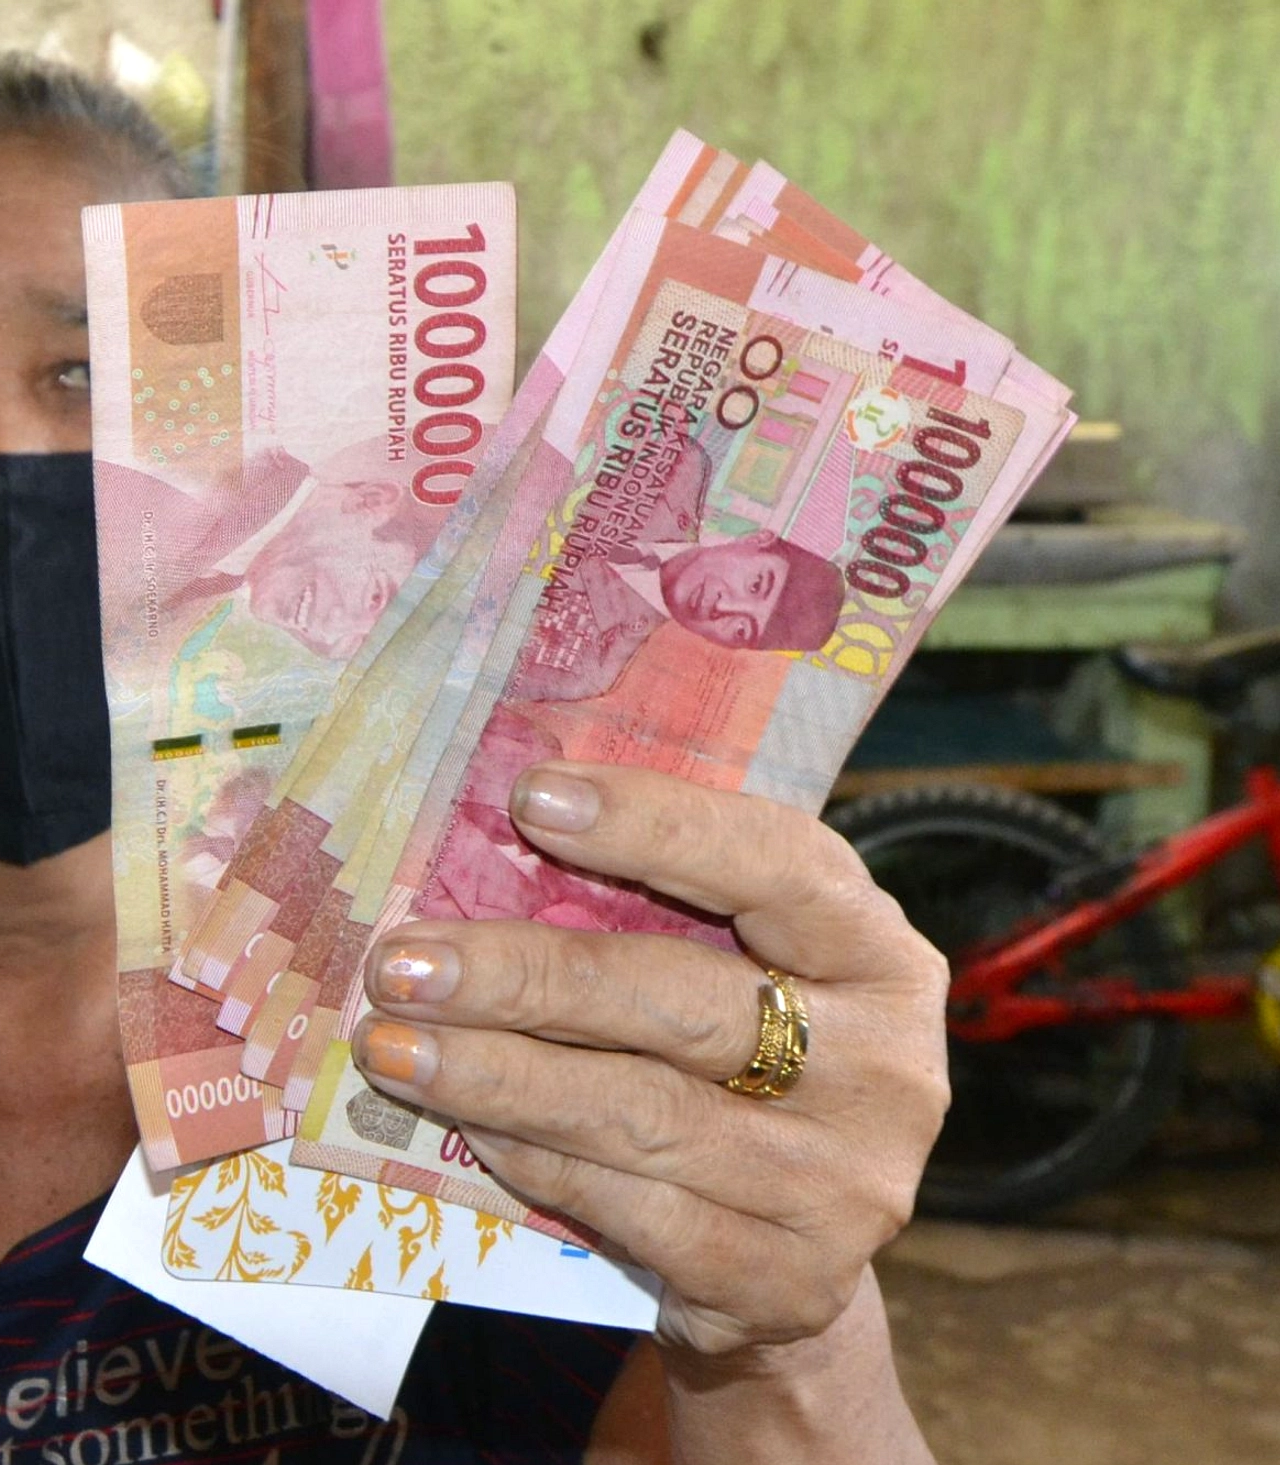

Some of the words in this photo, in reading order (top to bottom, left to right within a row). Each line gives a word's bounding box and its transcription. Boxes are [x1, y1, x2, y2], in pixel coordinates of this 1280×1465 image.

[388, 233, 406, 327] SERATUS
[389, 333, 407, 380] RIBU
[412, 223, 487, 505] 100000
[622, 311, 696, 439] SERATUS
[650, 320, 718, 438] REPUBLIK
[681, 327, 738, 426] NEGARA
[388, 387, 406, 461] RUPIAH
[586, 443, 633, 509] RIBU
[586, 441, 661, 560] INDONESIA
[618, 432, 689, 548] KESATUAN
[845, 407, 991, 598] 100000
[146, 577, 158, 637] SOEKARNO
[536, 513, 599, 613] RUPIAH
[158, 850, 171, 918] MOHAMMAD
[161, 920, 172, 953] HATTA
